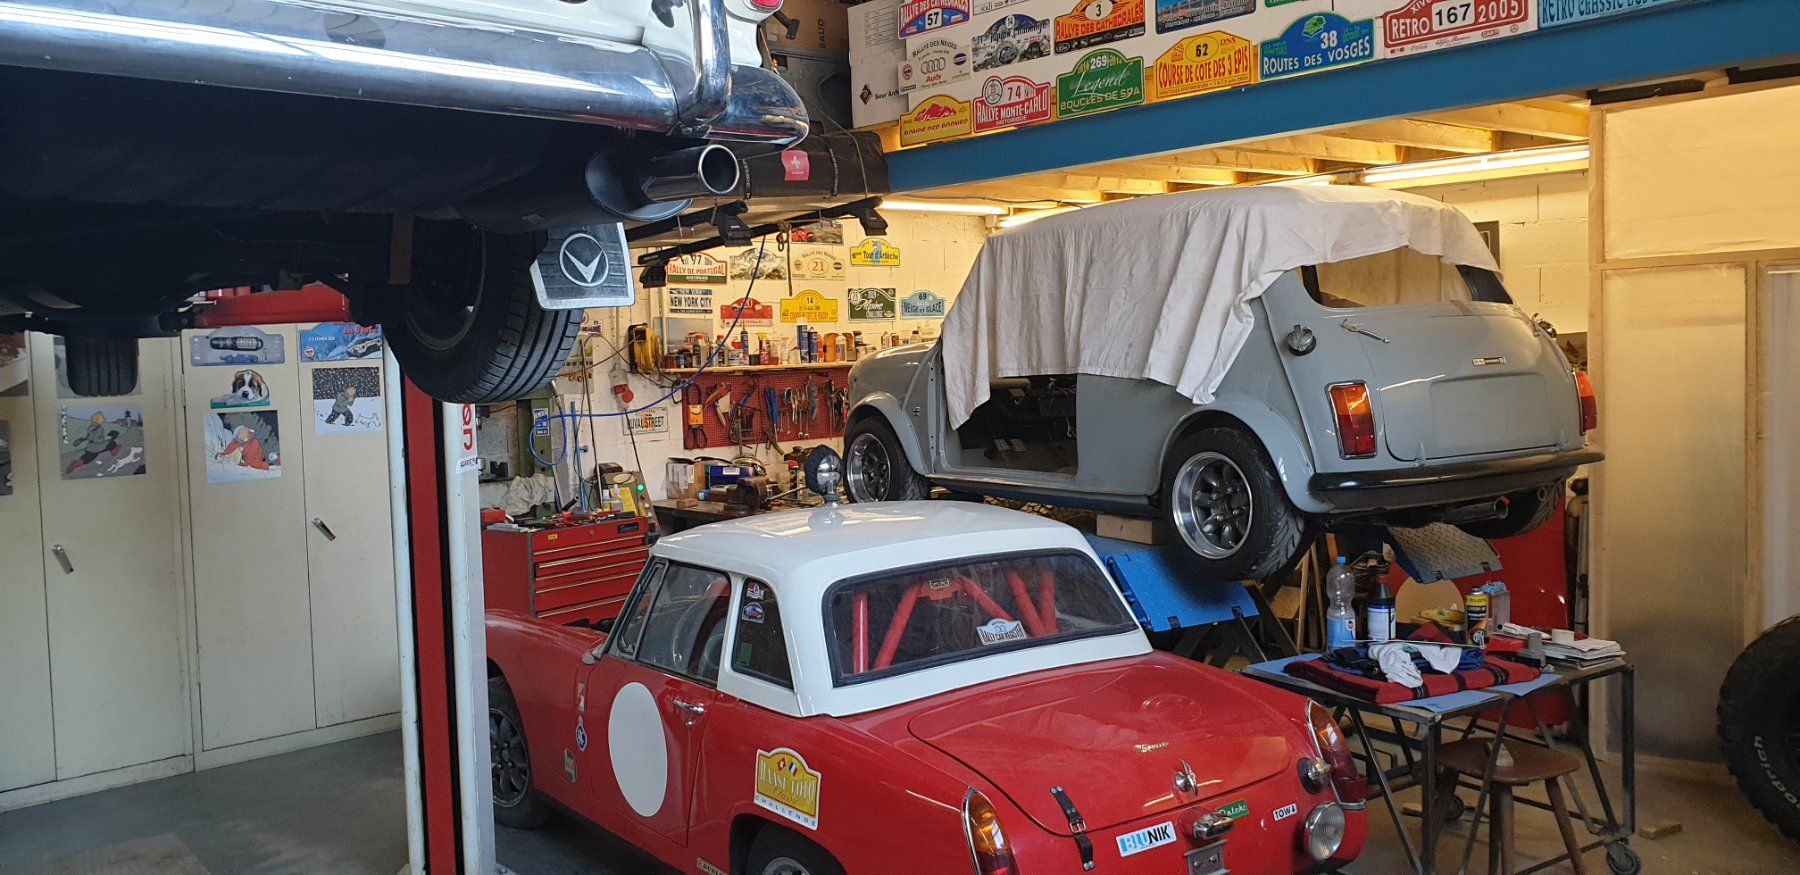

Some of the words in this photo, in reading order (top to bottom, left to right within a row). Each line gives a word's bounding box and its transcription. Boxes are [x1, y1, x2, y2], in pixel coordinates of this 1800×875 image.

[1096, 4, 1102, 17] 3
[1435, 3, 1471, 27] 167
[1477, 0, 1519, 22] 2005
[927, 12, 940, 26] 57
[1056, 20, 1080, 39] RALLYE
[1081, 22, 1094, 34] DES
[1096, 2, 1143, 31] CATHEDRALES
[1392, 17, 1430, 39] RETRO
[1320, 31, 1338, 49] 38
[912, 43, 929, 58] RALLYE
[1195, 44, 1208, 57] 62
[1263, 57, 1299, 75] ROUTES
[1304, 53, 1322, 67] DES
[1328, 35, 1370, 62] VOSGES
[1090, 55, 1107, 70] 269
[1160, 62, 1183, 88] COURSE
[1185, 65, 1193, 82] DE
[1195, 61, 1212, 81] COTE
[1213, 56, 1226, 78] DES
[1234, 45, 1249, 74] EPIS
[926, 74, 941, 83] Audi
[1073, 63, 1133, 97] Legend
[1007, 86, 1021, 101] 74
[1061, 93, 1103, 110] BOUCLES
[1105, 90, 1118, 100] DE
[1120, 87, 1140, 98] SPA
[977, 101, 999, 123] RALLYE
[1000, 88, 1048, 118] MONTE-CARLO
[863, 251, 873, 259] Tour
[669, 263, 686, 274] RALLY
[696, 264, 724, 274] PORTUGAL
[812, 260, 824, 271] 21
[670, 296, 682, 307] NEW
[684, 296, 698, 307] YORK
[700, 296, 712, 307] CITY
[904, 302, 918, 313] NEIGE
[926, 302, 941, 313] GLACE
[755, 795, 816, 827] CHALLENGE
[1275, 808, 1291, 819] TOW
[1120, 825, 1170, 852] BLUNIK
